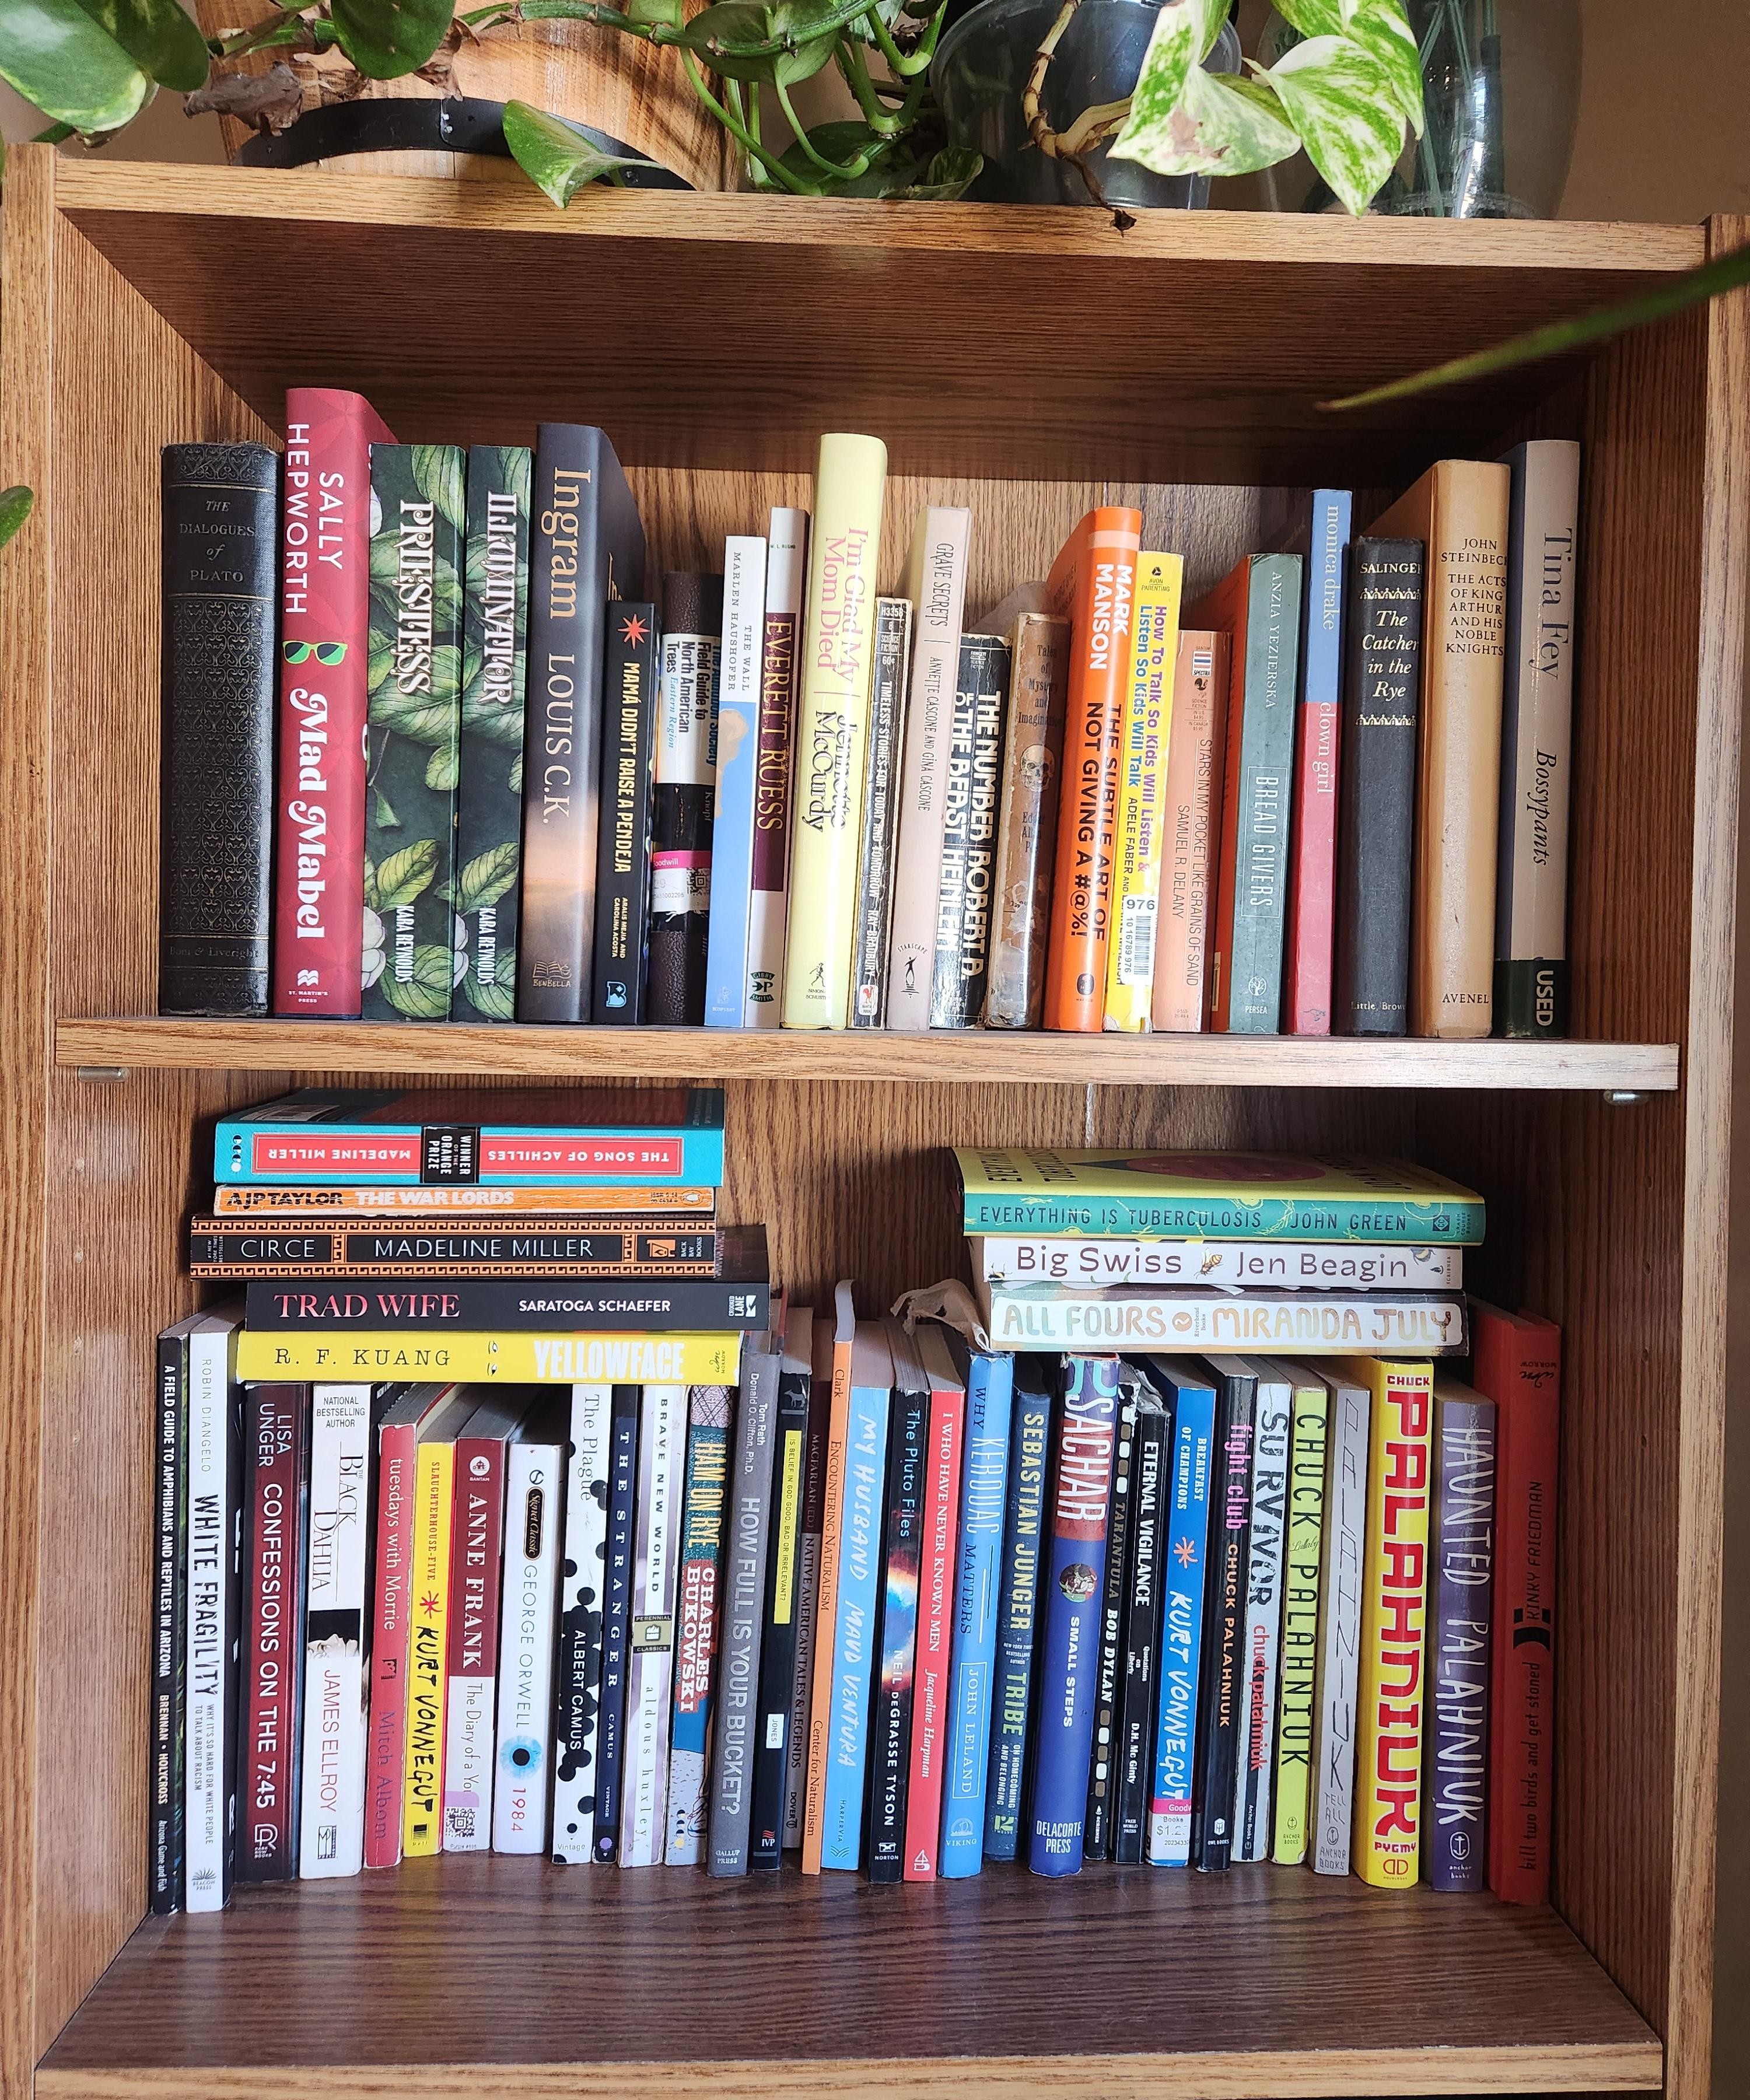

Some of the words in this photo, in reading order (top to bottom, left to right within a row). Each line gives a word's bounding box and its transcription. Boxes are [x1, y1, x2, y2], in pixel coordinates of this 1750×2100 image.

[205, 501, 230, 513] THE
[286, 424, 310, 614] HEPWORTH
[319, 471, 345, 570] SALLY
[180, 524, 256, 536] DIALOGUES
[541, 466, 592, 620] Ingram
[1325, 505, 1340, 573] monica
[1462, 538, 1497, 550] JOHN
[206, 544, 225, 559] of
[1542, 527, 1573, 606] Tina
[190, 569, 244, 582] PLATO
[732, 552, 741, 607] MARLEN
[1270, 572, 1282, 618] ANZIA
[1448, 574, 1475, 584] THE
[1479, 576, 1506, 587] ACTS
[1451, 589, 1468, 597] OF
[1472, 590, 1503, 600] KING
[1089, 564, 1114, 670] MANSON
[1112, 565, 1133, 636] MARK
[1322, 579, 1340, 630] drake
[1376, 610, 1408, 627] The
[1450, 602, 1502, 614] ARTHUR
[1451, 616, 1480, 626] AND
[1484, 618, 1503, 628] HIS
[1455, 629, 1496, 641] NOBLE
[667, 642, 680, 673] Trees
[681, 641, 695, 677] North
[729, 612, 738, 691] HAUSHOFER
[1363, 634, 1419, 651] Catcher
[1446, 644, 1504, 655] KNIGHTS
[1528, 622, 1570, 680] Fey
[622, 662, 640, 705] MAMÁ
[742, 656, 750, 691] WALL
[762, 621, 792, 741] EVERETT
[1266, 625, 1279, 709] YEZIERSKA
[1367, 659, 1383, 674] in
[1388, 659, 1412, 674] the
[669, 677, 678, 712] Eastern
[679, 680, 694, 733] American
[1373, 681, 1406, 702] Rye
[290, 688, 327, 792] Mad
[620, 706, 638, 755] DIDN'T
[667, 716, 675, 748] Region
[1318, 702, 1336, 758] clown
[618, 758, 636, 797] RAISE
[757, 748, 784, 831] RUESS
[1312, 760, 1333, 794] girl
[1254, 775, 1279, 834] BREAD
[1527, 749, 1557, 866] Bossypants
[614, 813, 633, 873] PENDEJA
[288, 802, 327, 939] Mabel
[1250, 844, 1275, 907] GIVERS
[396, 905, 414, 932] KARA
[395, 935, 414, 982] REYNOLDS
[1245, 1006, 1268, 1014] PERSEA
[1443, 993, 1489, 1003] AVENEL
[1536, 970, 1554, 1026] USED
[268, 1149, 325, 1158] MILLER
[332, 1150, 411, 1159] MADELINE
[488, 1150, 560, 1161] ACHILLES
[568, 1151, 587, 1161] OF
[594, 1151, 634, 1161] SONG
[642, 1152, 669, 1162] THE
[981, 1206, 1091, 1224] EVERYTHING
[1102, 1209, 1117, 1224] IS
[1130, 1210, 1261, 1227] TUBERCULOSIS
[1291, 1213, 1337, 1229] JOHN
[1350, 1214, 1406, 1231] GREEN
[241, 1240, 315, 1257] CIRCE
[1018, 1245, 1069, 1277] Big
[1080, 1247, 1181, 1273] Swiss
[1237, 1252, 1285, 1277] Jen
[1301, 1253, 1406, 1282] Beagin
[274, 1294, 368, 1318] TRAD
[370, 1294, 460, 1317] WIFE
[519, 1300, 593, 1311] SARATOGA
[598, 1300, 670, 1311] SCHAEFER
[734, 1296, 745, 1317] LANE
[275, 1349, 299, 1364] R.
[316, 1349, 336, 1364] F.
[353, 1349, 450, 1366] KUANG
[534, 1340, 684, 1379] YELLOWFACE
[202, 1359, 212, 1399] ROBIN
[1387, 1375, 1430, 1386] CHUCK
[324, 1397, 358, 1405] NATIONAL
[583, 1394, 600, 1429] The
[201, 1407, 212, 1472] DIANGELO
[258, 1403, 275, 1466] UNGER
[277, 1415, 292, 1454] LISA
[326, 1419, 355, 1427] AUTHOR
[658, 1399, 667, 1460] BRAVE
[907, 1410, 921, 1441] The
[578, 1437, 598, 1501] Plague
[1225, 1424, 1252, 1475] fight
[902, 1448, 918, 1491] Pluto
[1140, 1442, 1159, 1514] ETERNAL
[384, 1460, 403, 1527] tuesdays
[656, 1474, 664, 1513] NEW
[1226, 1485, 1249, 1530] club
[428, 1461, 440, 1580] SLAUGHTERHOUSE-FIVE
[900, 1499, 915, 1537] Files
[1528, 1481, 1543, 1566] FRIEDMAN
[386, 1534, 402, 1569] with
[653, 1527, 662, 1592] WORLD
[1290, 1536, 1320, 1552] Lullaby
[1135, 1522, 1155, 1606] VIGILANCE
[384, 1576, 401, 1630] Morrie
[521, 1565, 537, 1644] GEORGE
[1525, 1572, 1542, 1620] KINKY
[1068, 1616, 1080, 1671] SMALL
[1135, 1658, 1141, 1668] on
[1142, 1646, 1150, 1681] Quotations
[517, 1654, 533, 1727] ORWELL
[922, 1668, 938, 1724] Jacqueline
[966, 1669, 978, 1716] JOHN
[1003, 1672, 1027, 1737] TRIBE
[1063, 1676, 1076, 1727] STEPS
[921, 1726, 934, 1779] Harpman
[962, 1723, 975, 1793] LELAND
[512, 1788, 526, 1832] 1984
[838, 1800, 846, 1842] HARPERVIA
[1037, 1821, 1082, 1836] DELACORTE
[762, 1839, 775, 1847] IVP
[1046, 1839, 1070, 1853] PRESS
[1374, 1842, 1416, 1853] PYGMY
